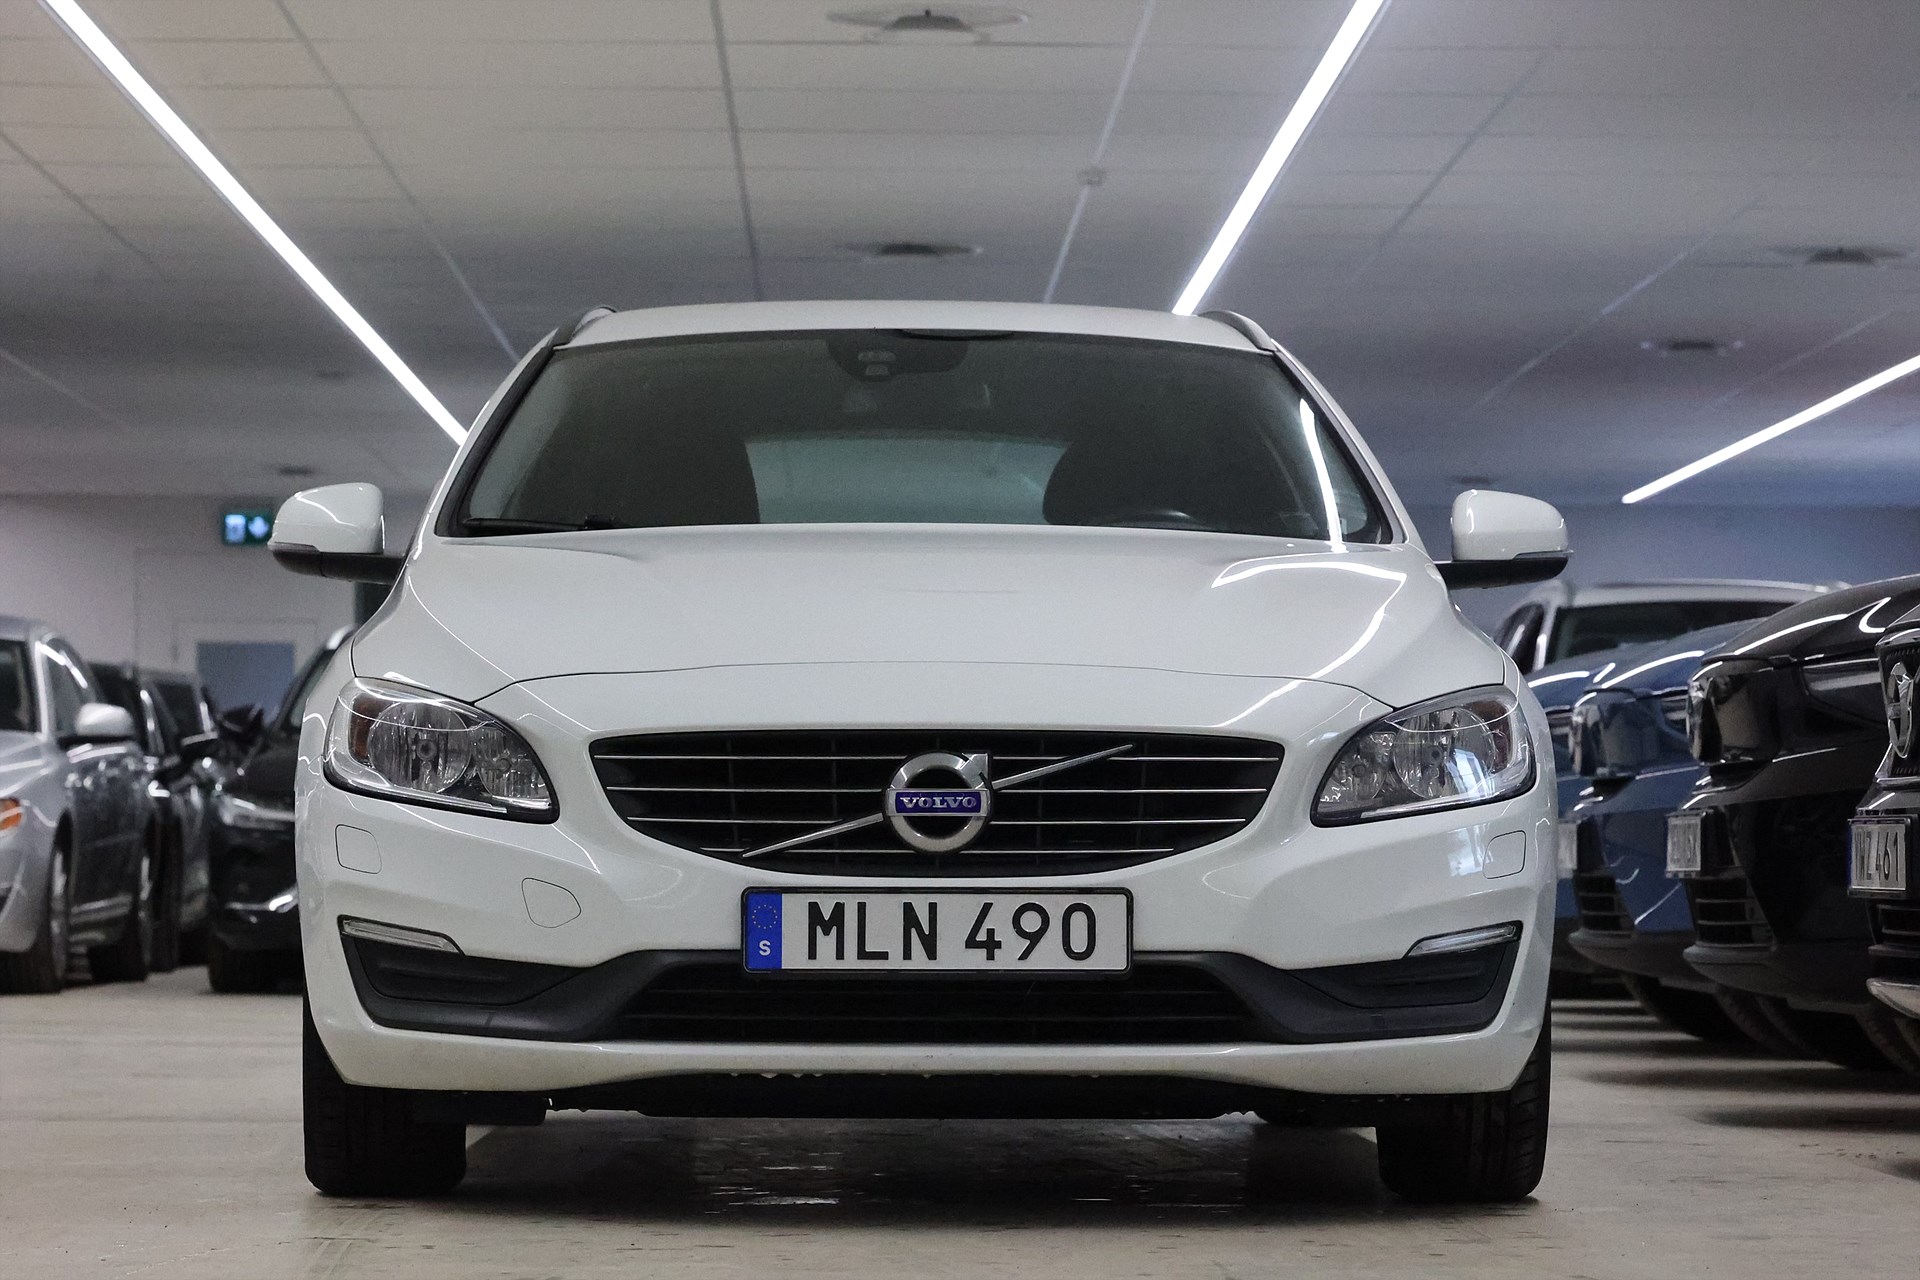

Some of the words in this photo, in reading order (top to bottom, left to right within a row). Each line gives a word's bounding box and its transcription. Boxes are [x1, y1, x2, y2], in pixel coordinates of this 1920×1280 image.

[899, 796, 977, 809] VOLVO
[1875, 831, 1899, 882] 461
[758, 939, 772, 957] S
[807, 901, 938, 961] MLN
[964, 901, 1097, 962] 490
